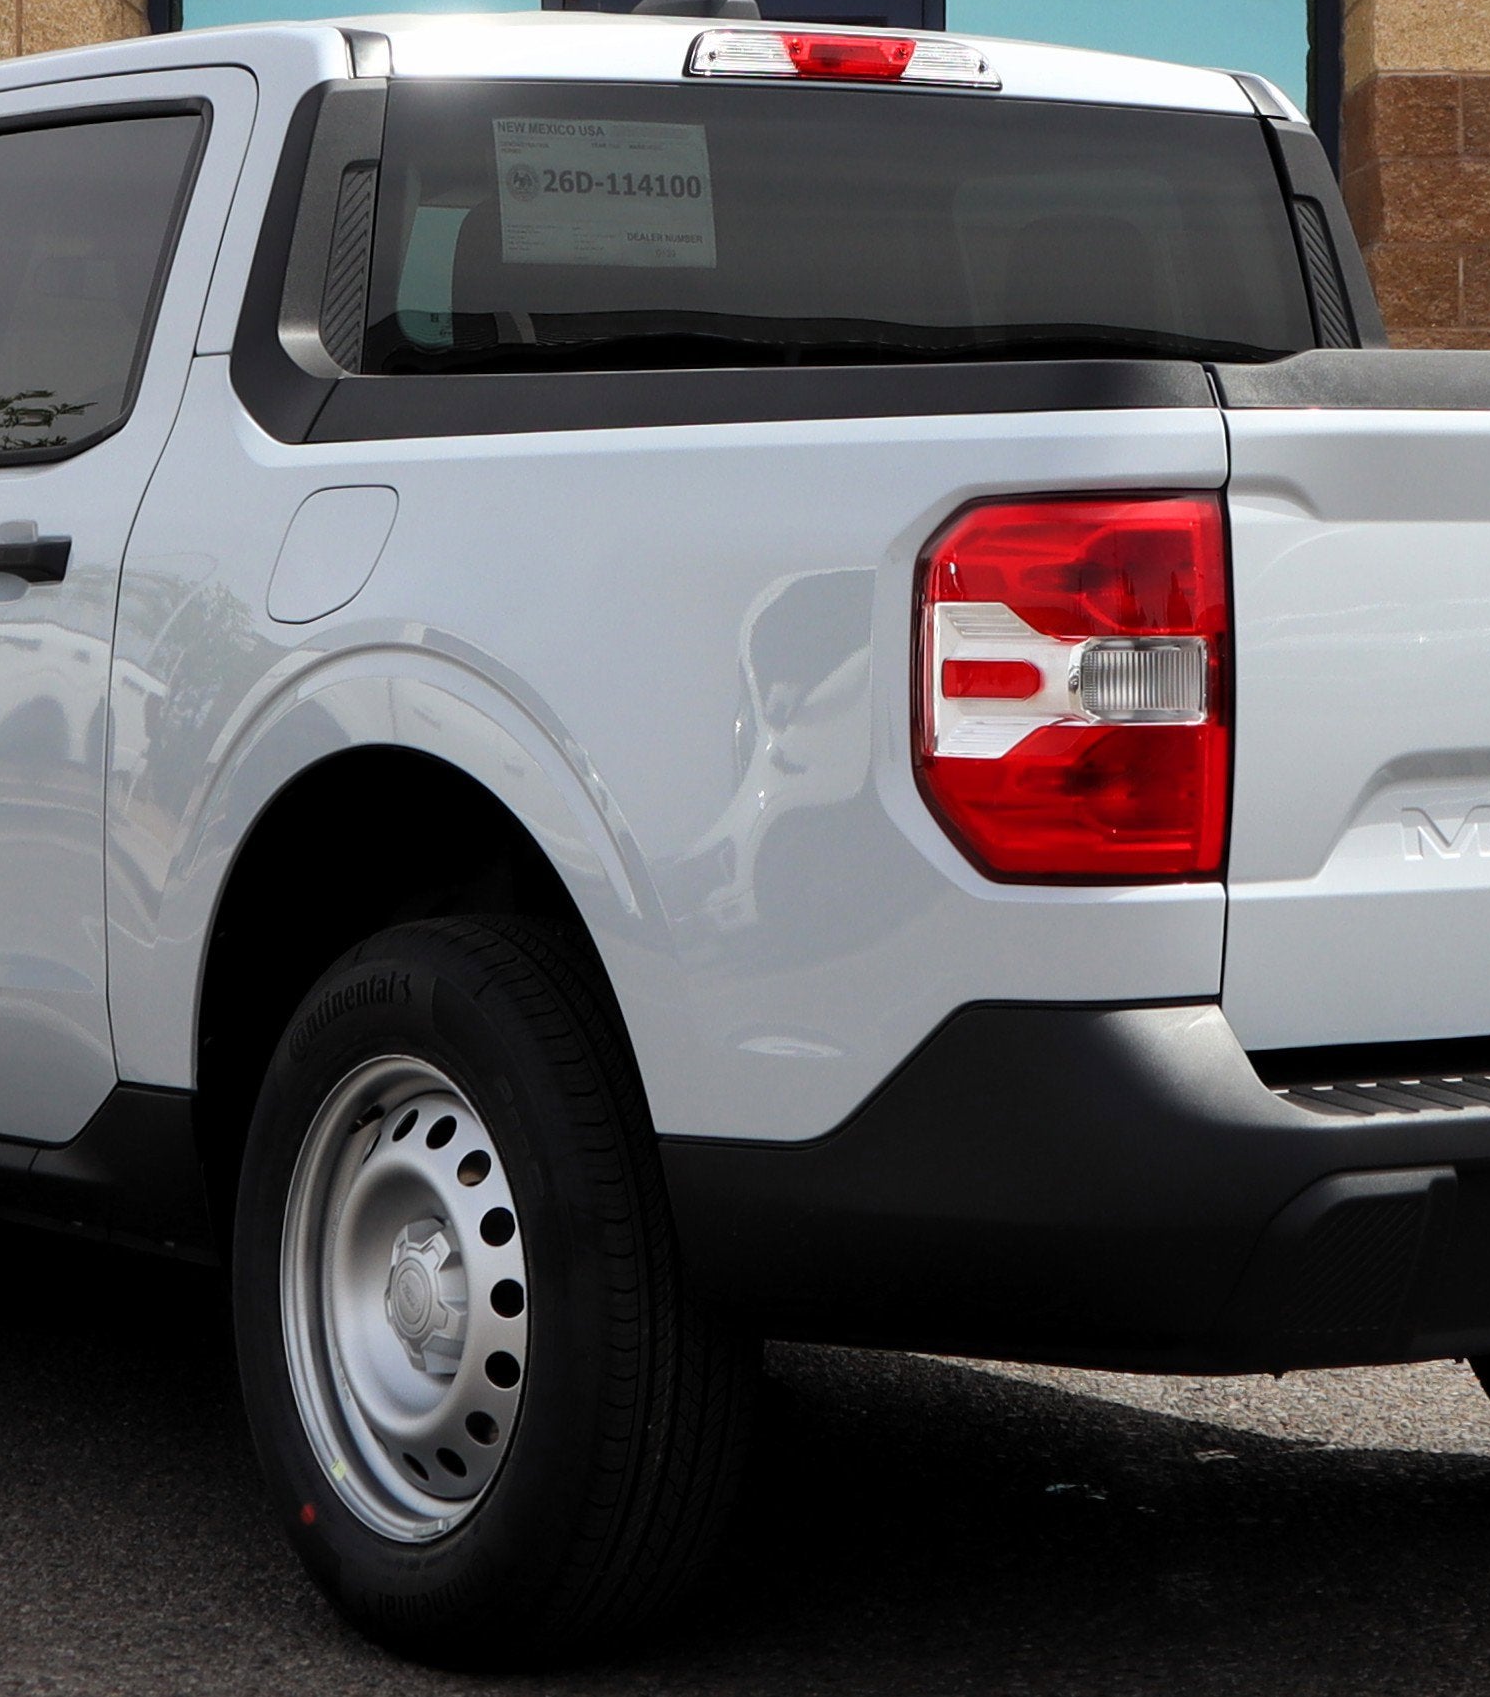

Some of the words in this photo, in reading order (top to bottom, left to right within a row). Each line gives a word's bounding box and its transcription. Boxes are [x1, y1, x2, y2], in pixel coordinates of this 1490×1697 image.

[497, 121, 525, 133] NEW
[529, 122, 576, 136] MEXICO
[578, 125, 605, 137] USA
[542, 169, 702, 199] 26D-114100
[627, 232, 663, 243] DEALER
[665, 233, 703, 245] NUMBER
